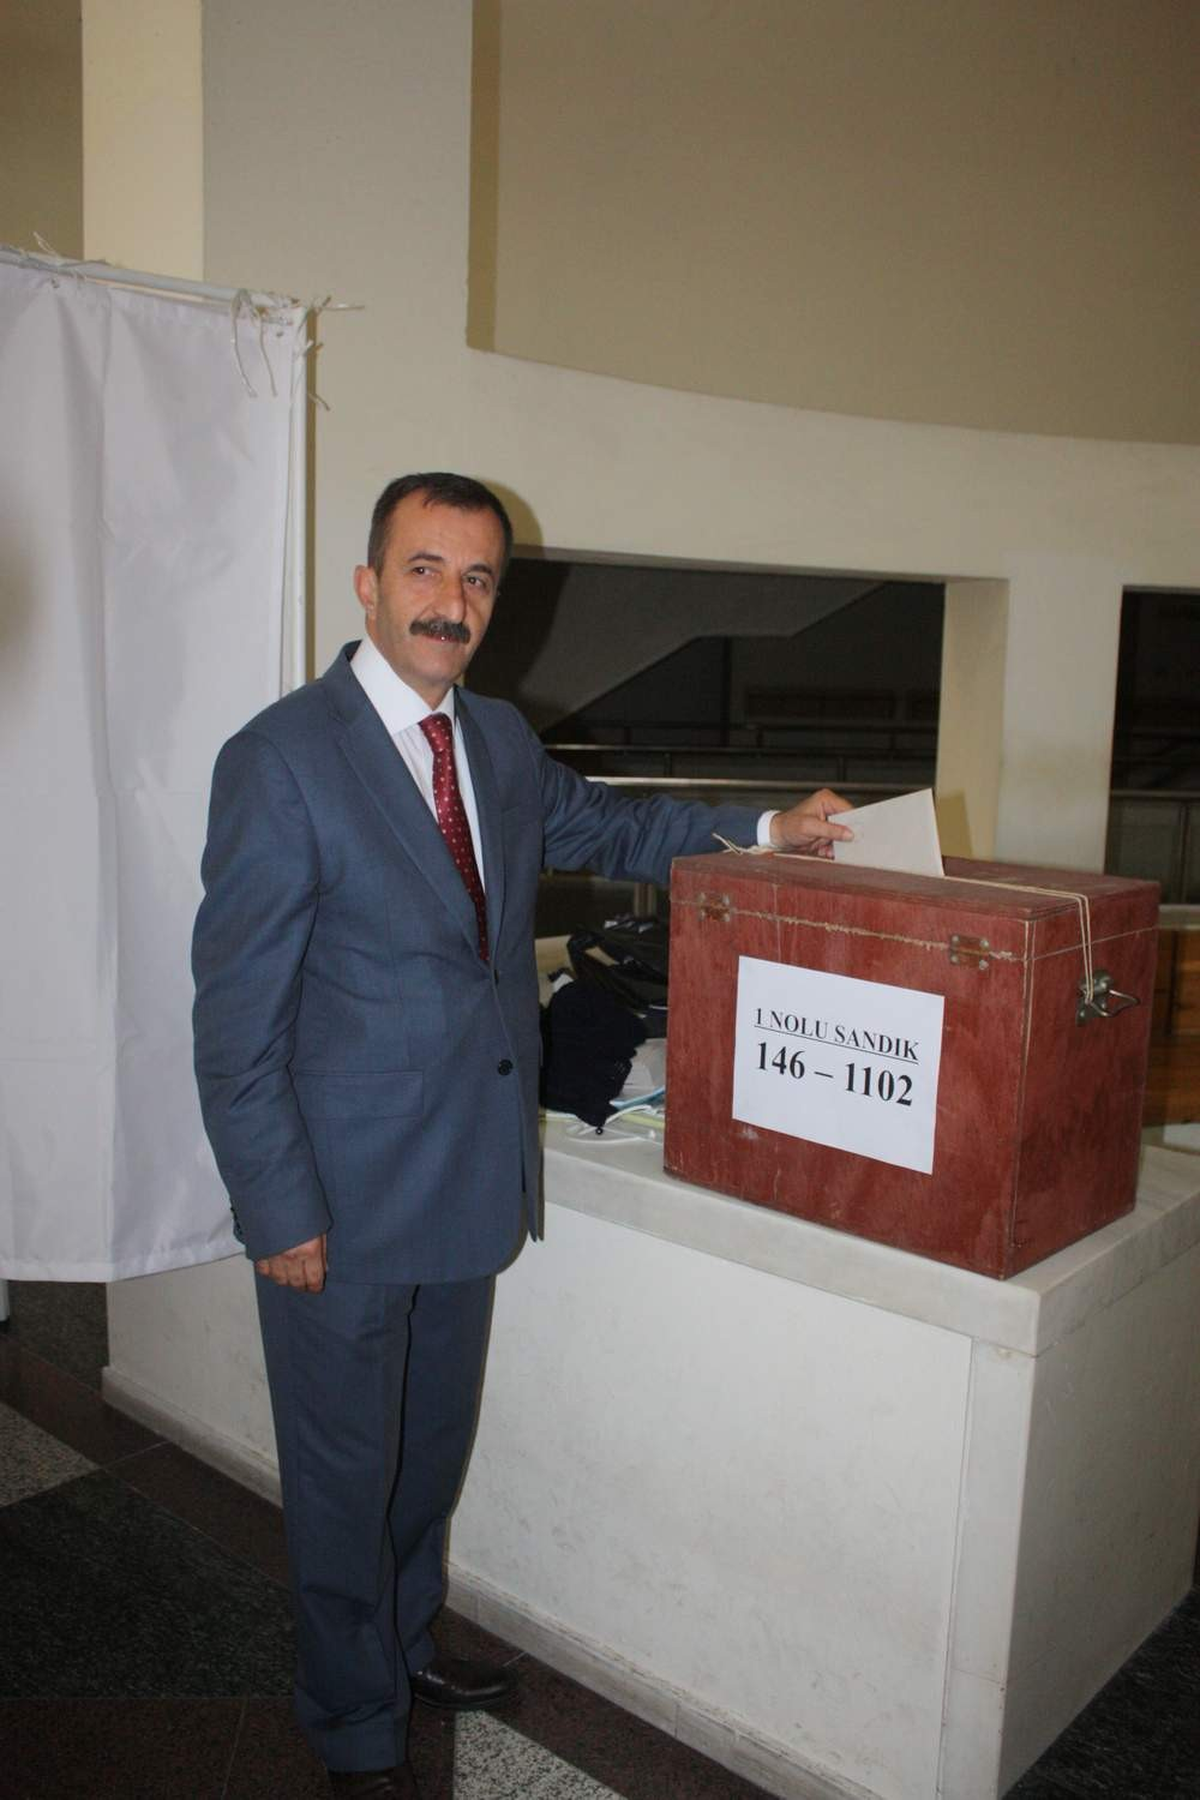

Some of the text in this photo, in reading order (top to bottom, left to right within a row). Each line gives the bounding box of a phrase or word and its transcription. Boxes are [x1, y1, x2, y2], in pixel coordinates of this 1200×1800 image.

[756, 1008, 919, 1061] 1 NOLU SANDIK
[758, 1042, 806, 1080] 146
[846, 1062, 913, 1107] 1102
